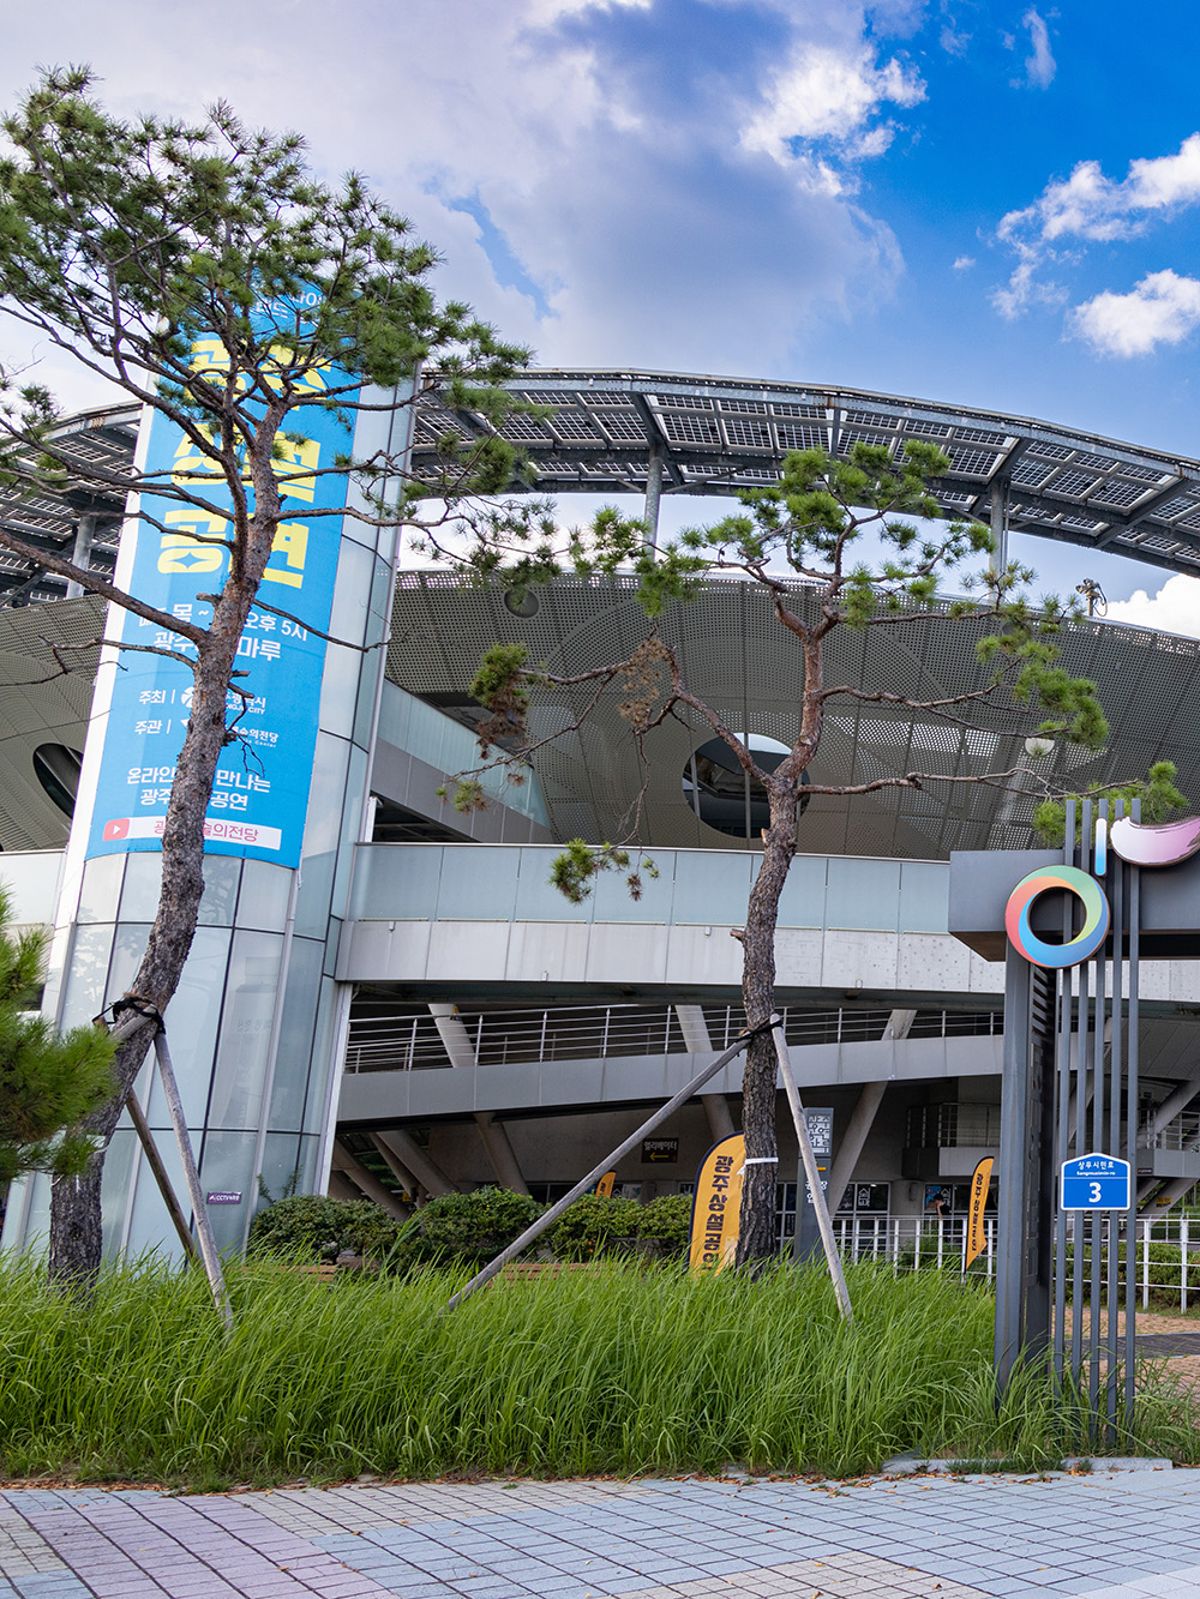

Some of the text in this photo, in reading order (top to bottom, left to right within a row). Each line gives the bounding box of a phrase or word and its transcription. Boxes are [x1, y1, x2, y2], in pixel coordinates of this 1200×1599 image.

[243, 612, 276, 632] 오후
[281, 621, 308, 641] 5시
[139, 689, 166, 705] 주최
[135, 720, 162, 735] 주관
[216, 769, 271, 793] 만나는
[1088, 1182, 1102, 1203] 3
